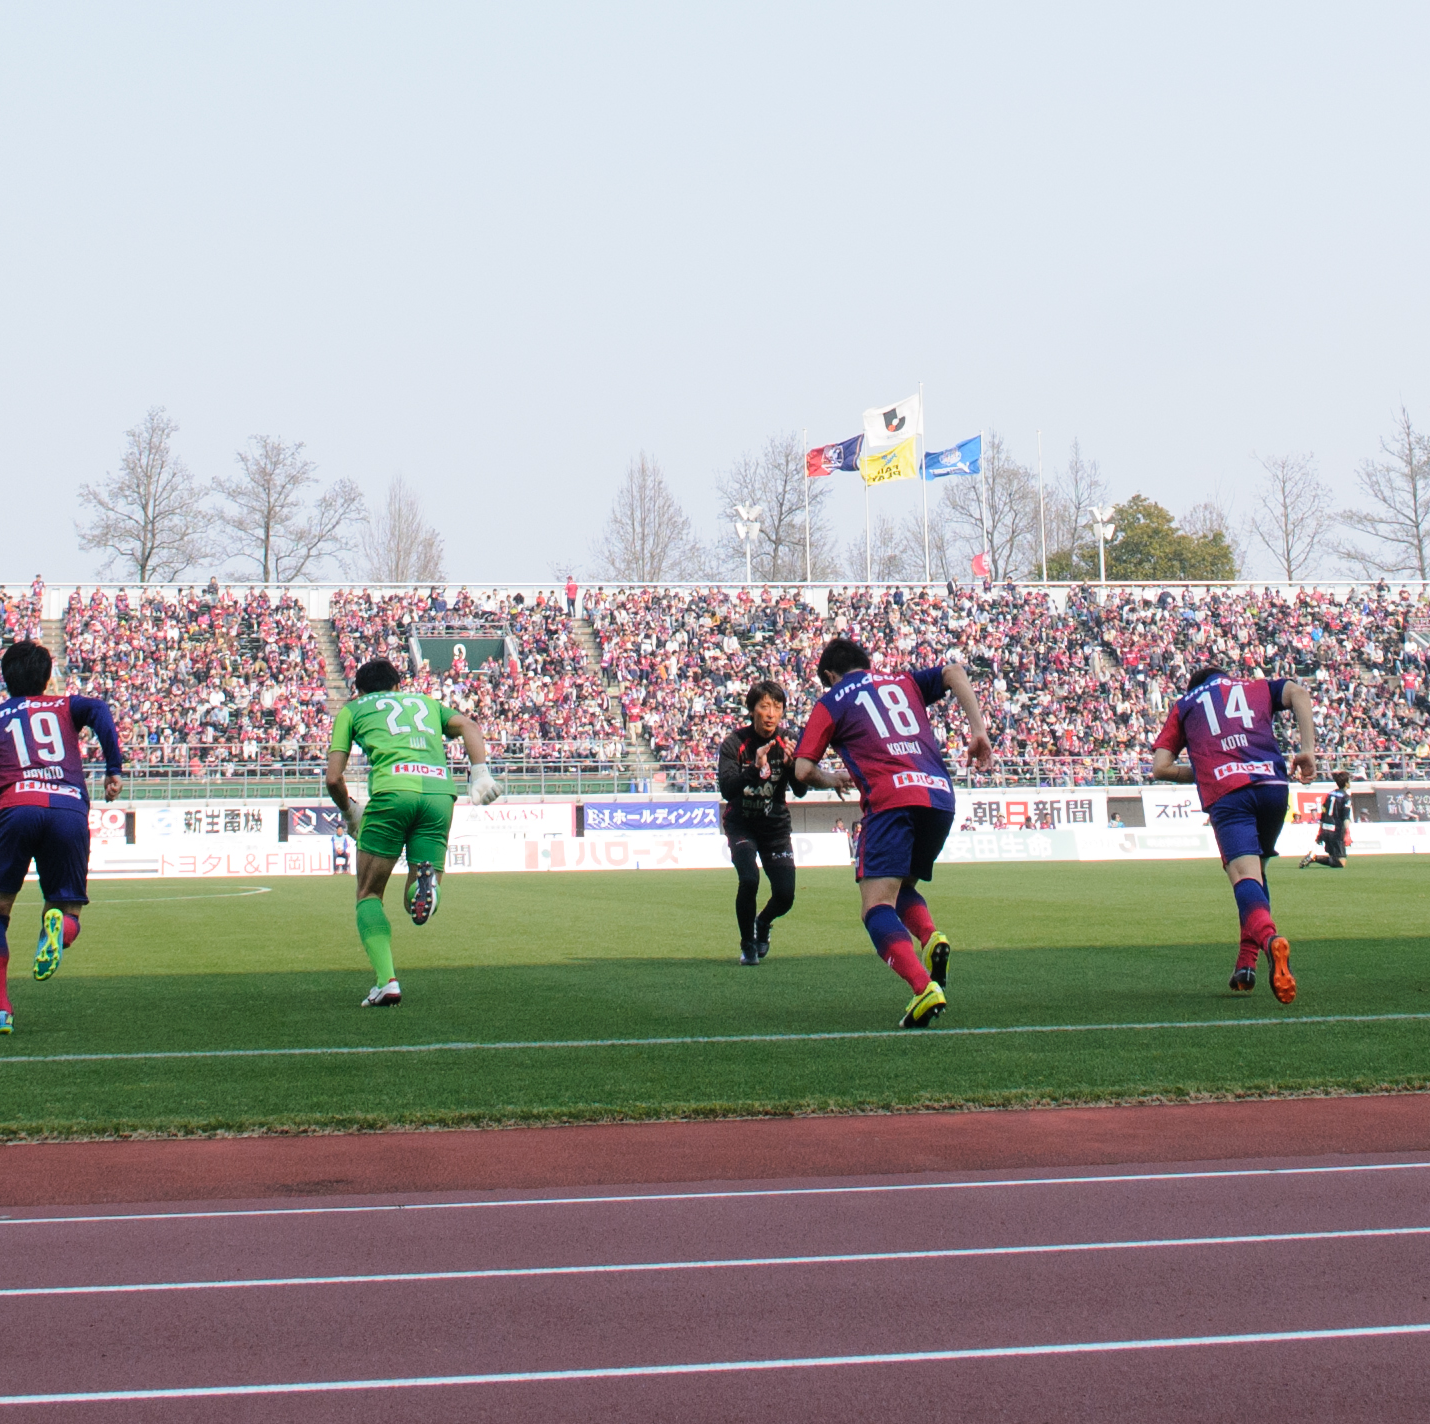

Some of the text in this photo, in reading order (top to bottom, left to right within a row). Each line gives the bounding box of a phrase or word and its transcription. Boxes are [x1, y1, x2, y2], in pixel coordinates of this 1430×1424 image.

[375, 697, 436, 736] 22
[854, 683, 920, 739] 18
[1195, 684, 1255, 736] 14
[4, 711, 66, 768] 19
[887, 741, 922, 756] KAZUKI
[1221, 733, 1249, 752] KOTA
[411, 764, 445, 777] ハローズ
[183, 809, 263, 834] 新生電機
[972, 799, 1094, 826] 朝日新聞
[575, 841, 680, 867] ハローズ
[945, 832, 1053, 860] 安田生命
[160, 852, 332, 875] トヨタL&F岡山
